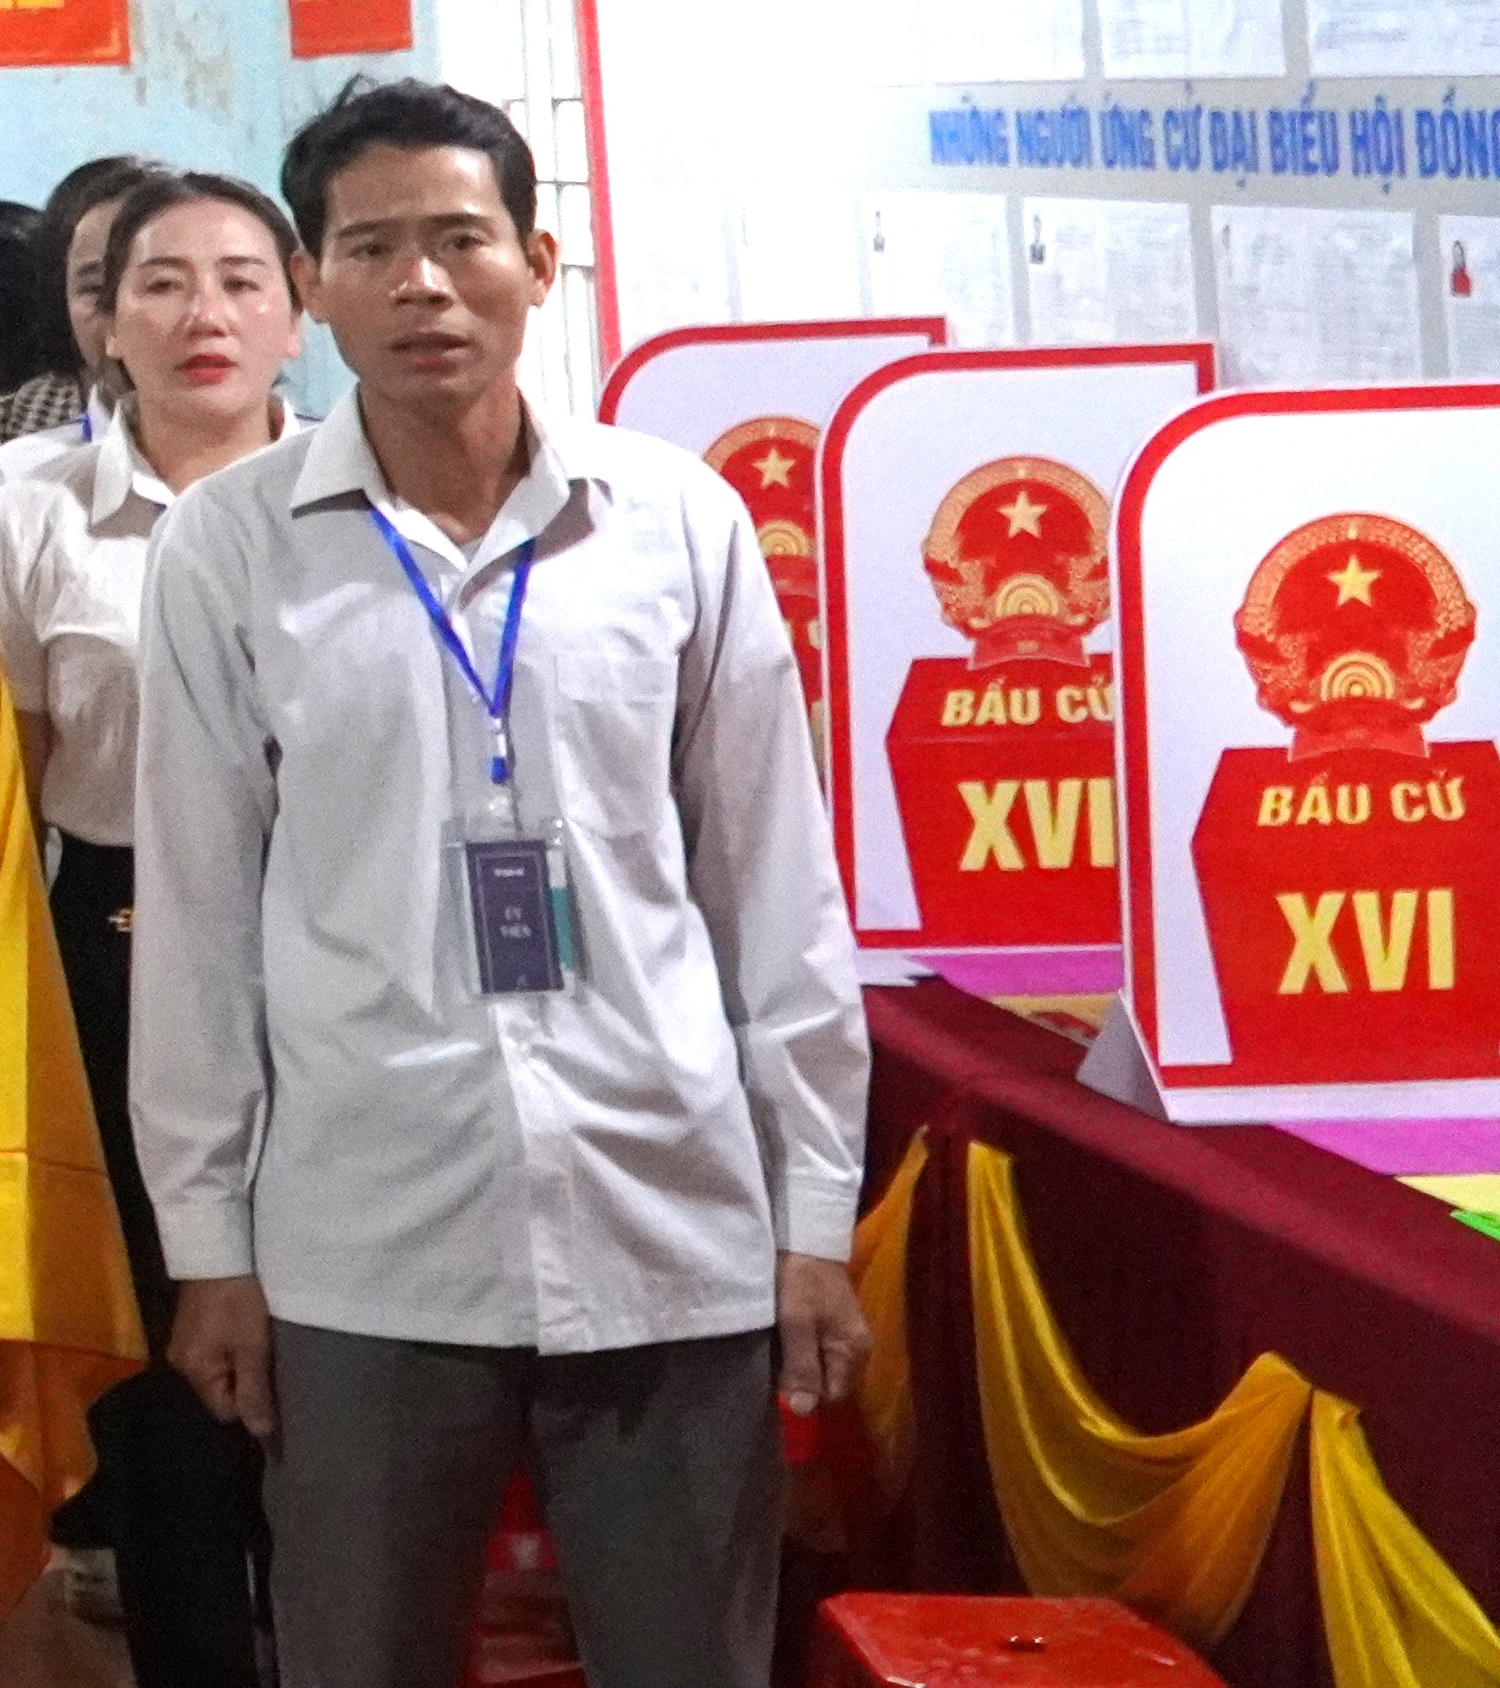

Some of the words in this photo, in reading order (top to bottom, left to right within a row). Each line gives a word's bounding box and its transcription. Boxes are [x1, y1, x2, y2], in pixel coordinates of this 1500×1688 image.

[1014, 92, 1091, 168] NGƯỜI
[1102, 91, 1156, 169] ỨNG
[1163, 80, 1202, 170] CỬ
[1208, 109, 1259, 188] ĐẠI
[1268, 81, 1340, 175] BIỂU
[1348, 95, 1406, 193] HỘI
[941, 674, 1038, 727] BẦU
[957, 777, 1116, 872] XVI
[1257, 770, 1372, 827] BẦU
[1389, 768, 1466, 823] CỬ
[1276, 888, 1456, 996] XVI
